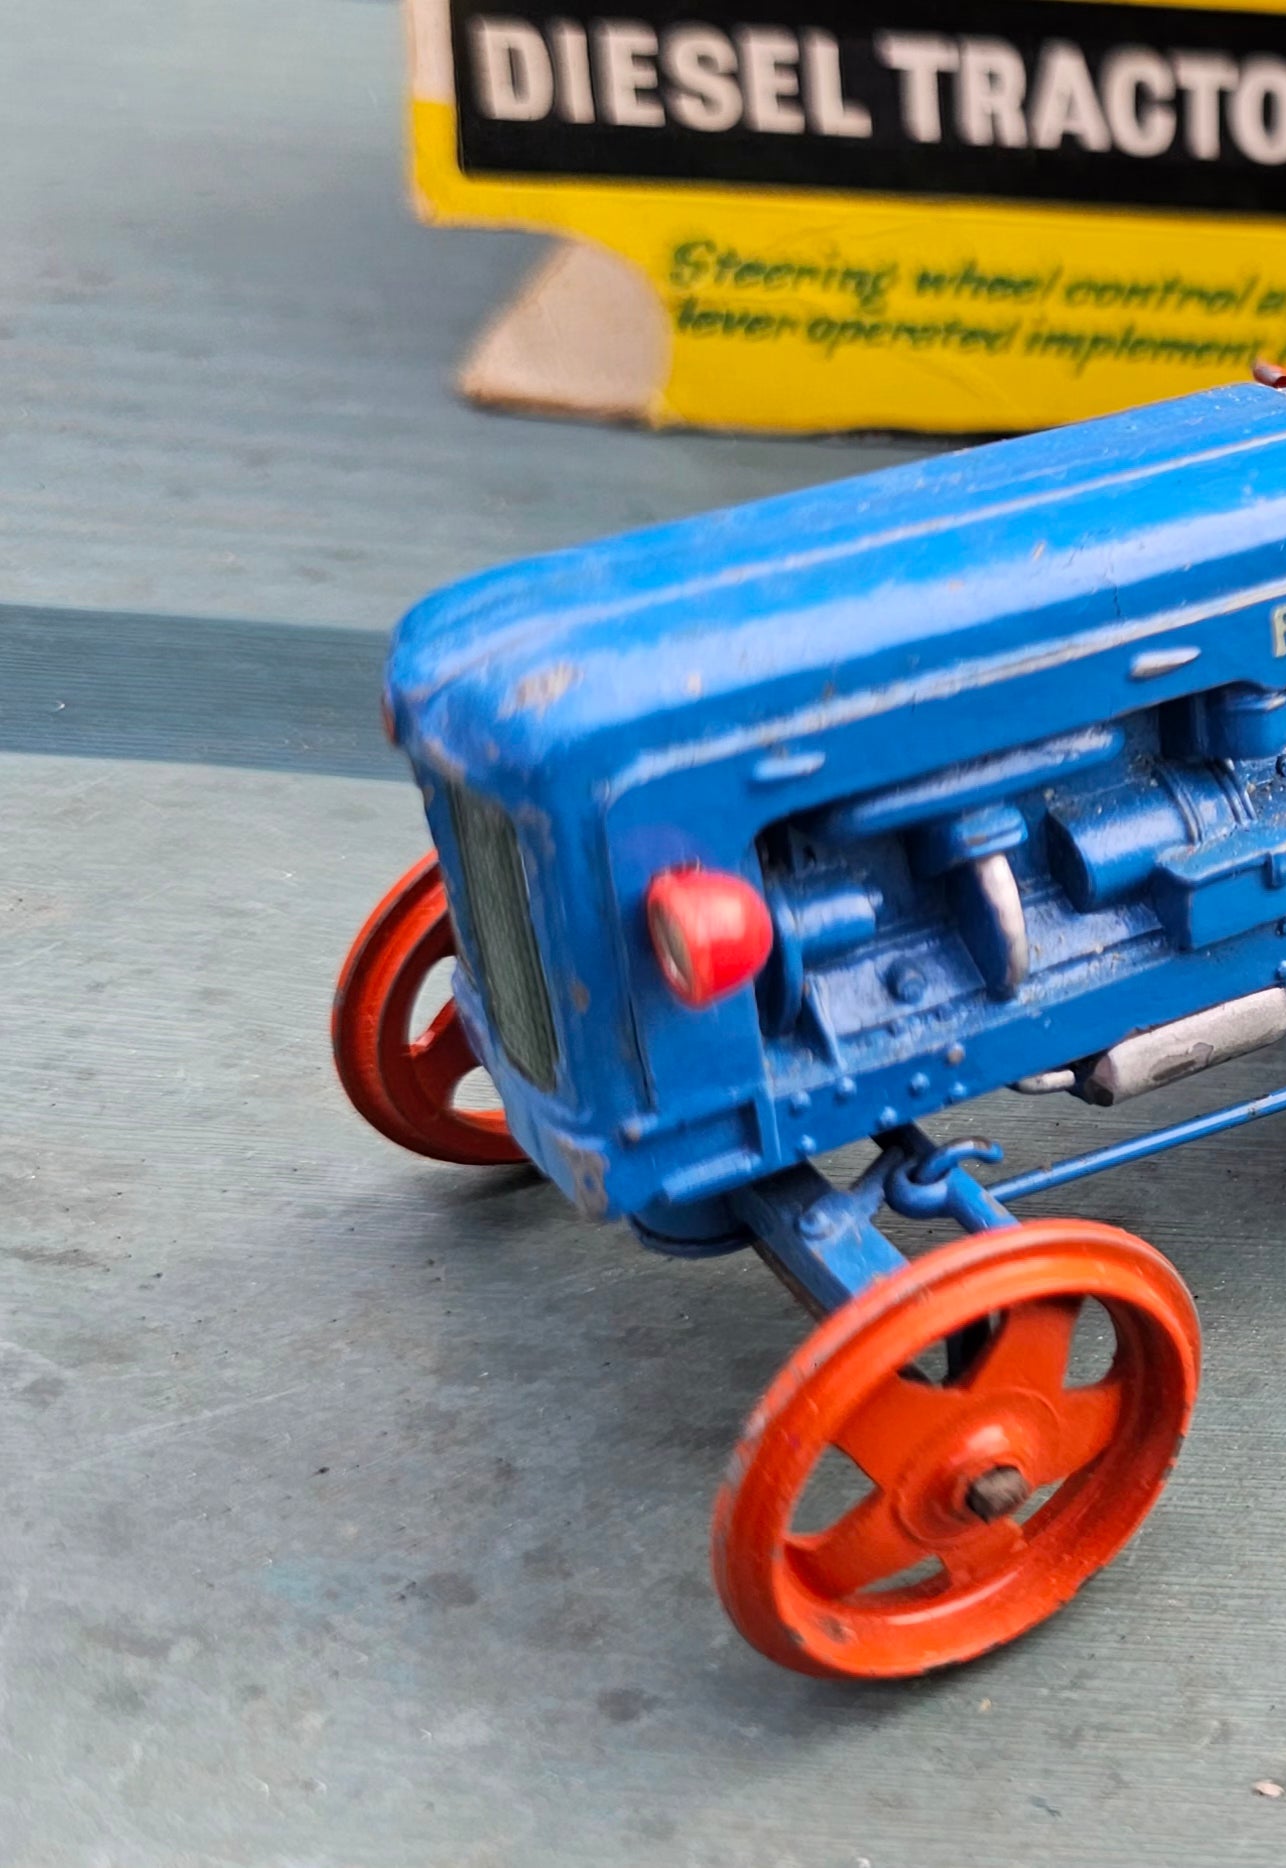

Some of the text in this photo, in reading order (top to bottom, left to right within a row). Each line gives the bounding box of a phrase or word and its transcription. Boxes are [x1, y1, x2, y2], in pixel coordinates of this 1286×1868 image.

[470, 15, 874, 138] DIESEL
[670, 238, 897, 315] Steering
[914, 258, 1064, 302] wheel
[1064, 260, 1262, 316] control
[677, 297, 800, 342] lever
[804, 311, 1024, 363] operated
